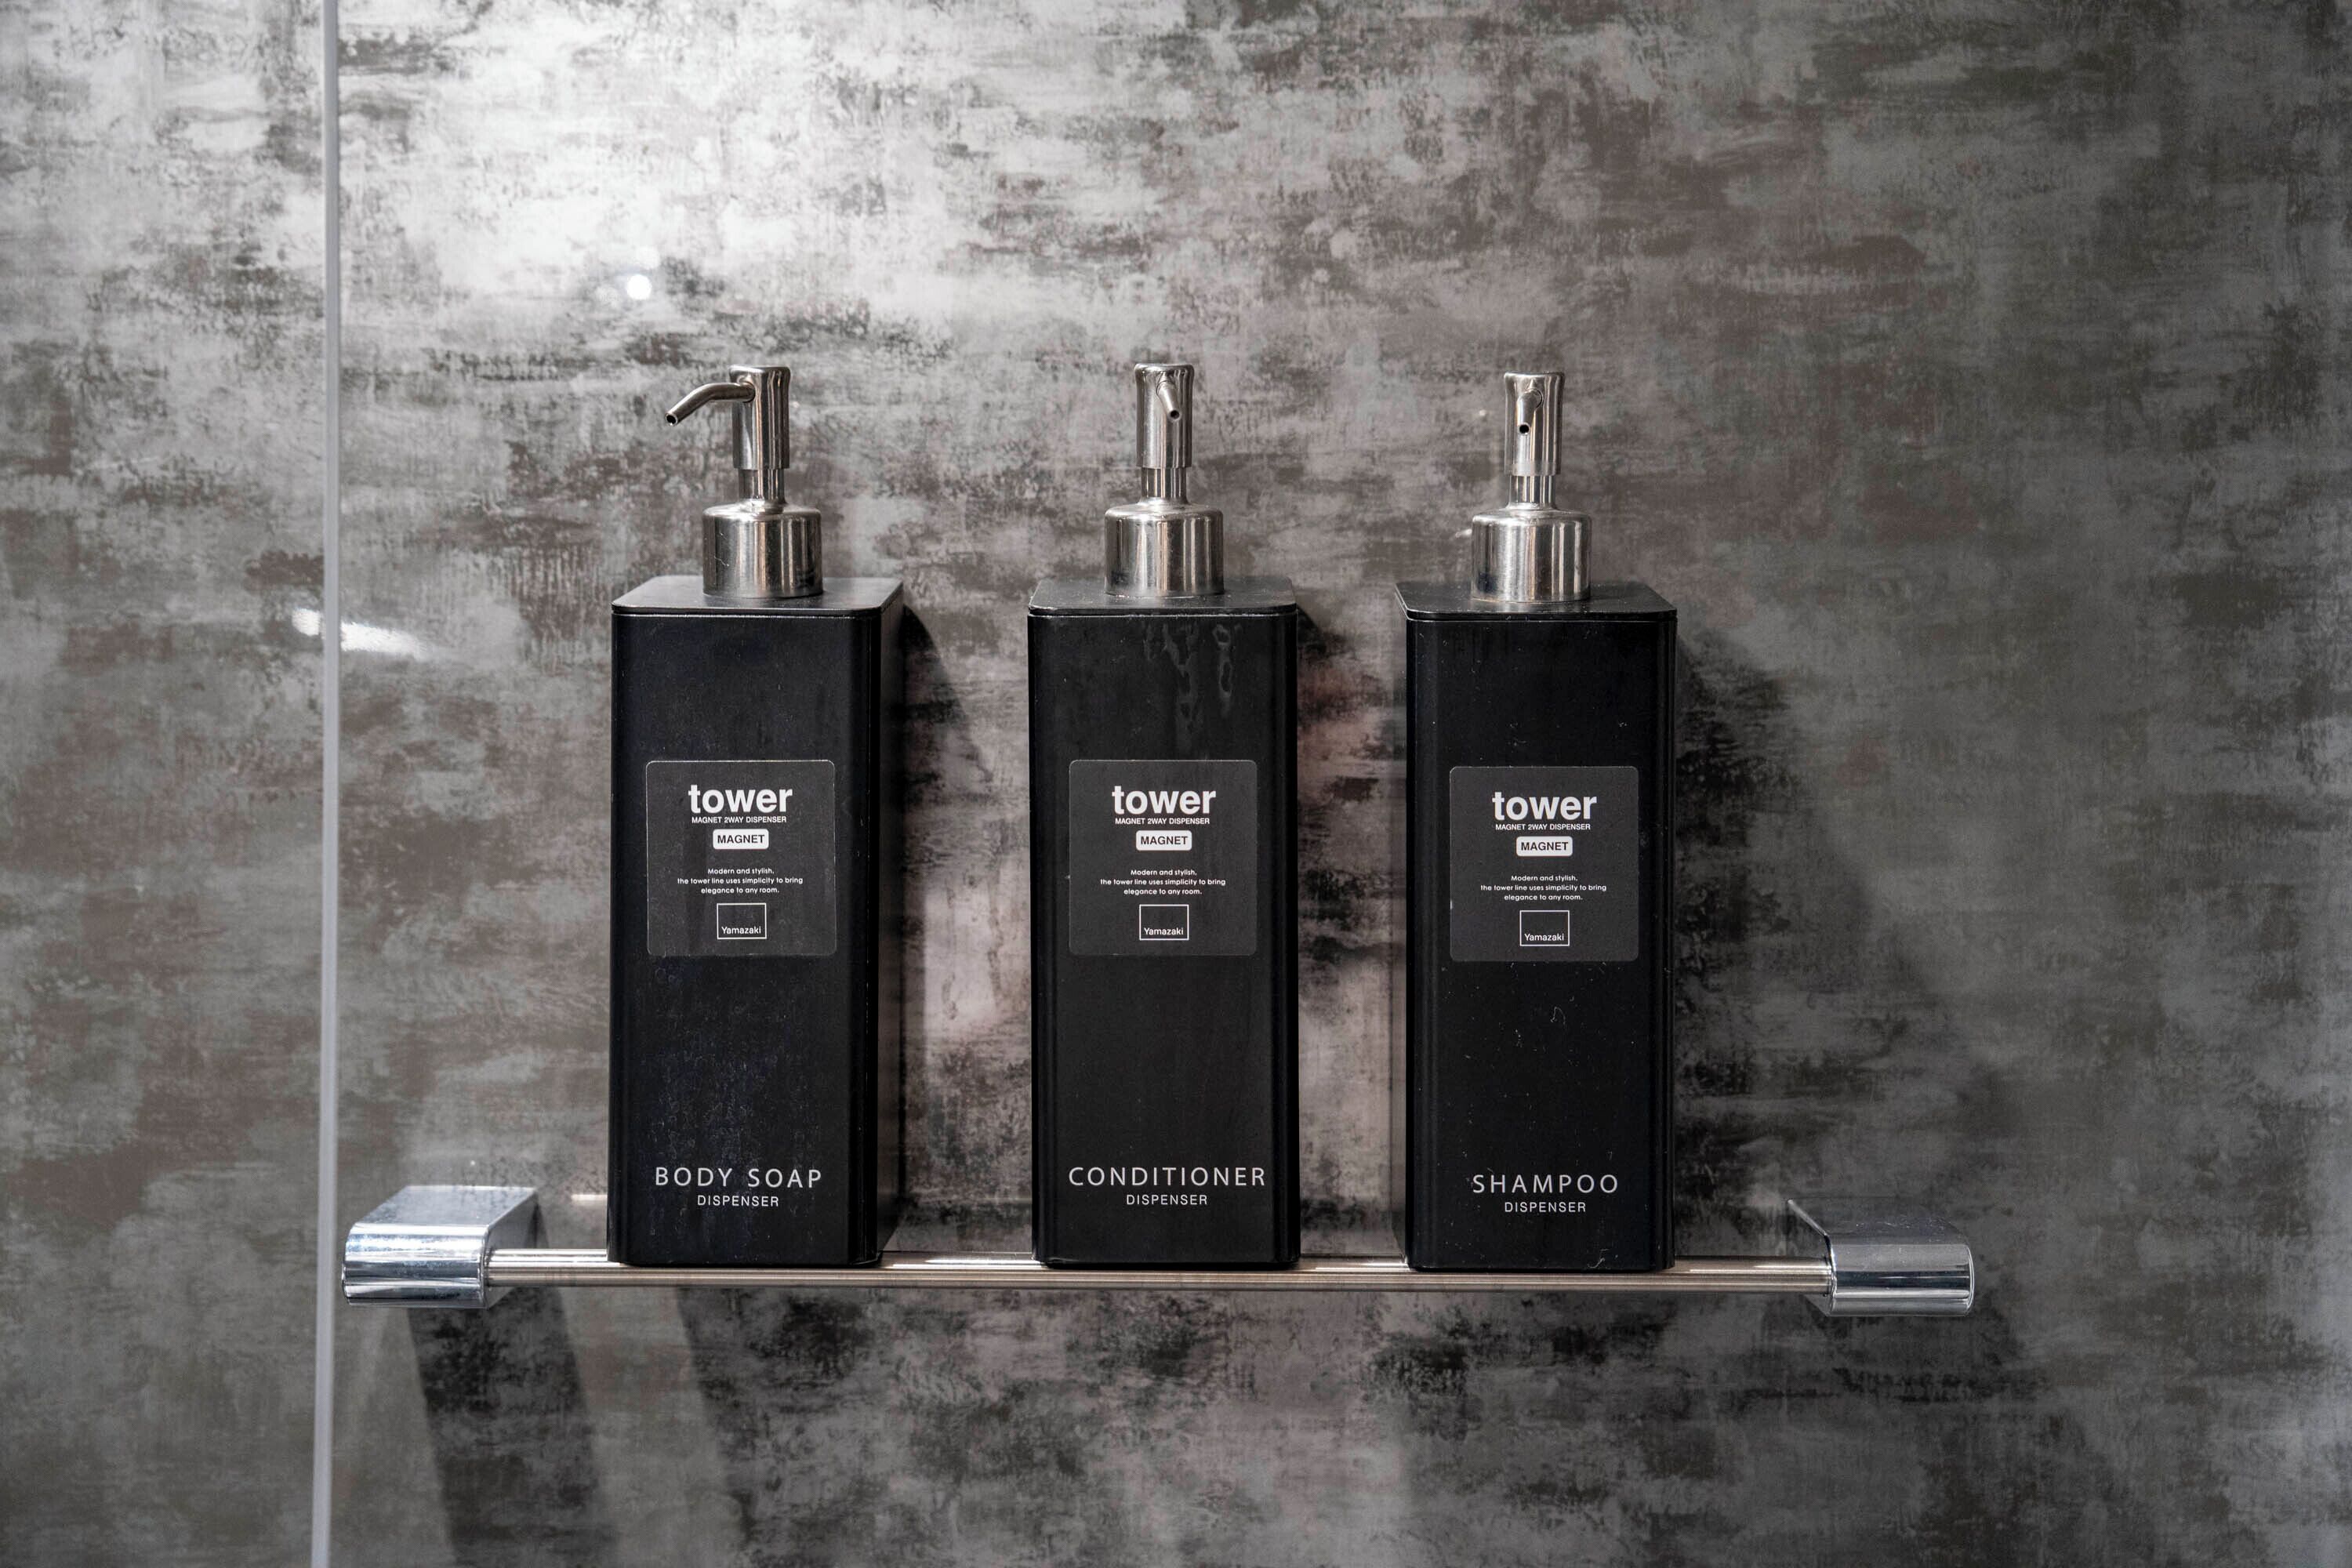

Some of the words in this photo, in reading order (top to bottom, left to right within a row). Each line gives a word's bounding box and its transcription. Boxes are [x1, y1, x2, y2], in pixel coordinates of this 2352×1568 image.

[688, 784, 793, 814] tower
[1111, 785, 1217, 815] tower
[1491, 791, 1598, 821] tower
[717, 834, 765, 844] MAGNET
[1140, 835, 1189, 845] MAGNET
[1520, 840, 1569, 851] MAGNET
[742, 877, 775, 885] simplicity
[784, 877, 804, 885] bring
[1207, 878, 1226, 887] bring
[701, 887, 735, 895] elegance
[1123, 887, 1158, 896] elegance
[1588, 884, 1607, 892] bring
[721, 926, 761, 935] Yamazaki
[1143, 927, 1184, 935] Yamazaki
[1524, 933, 1564, 942] Yamazaki
[655, 1167, 733, 1187] BODY
[747, 1168, 822, 1189] SOAP
[1069, 1167, 1265, 1186] CONDITIONER
[1472, 1174, 1618, 1194] SHAMPOO
[697, 1194, 779, 1207] DISPENSER
[1126, 1194, 1208, 1206] DISPENSER
[1504, 1201, 1587, 1213] DISPENSER
